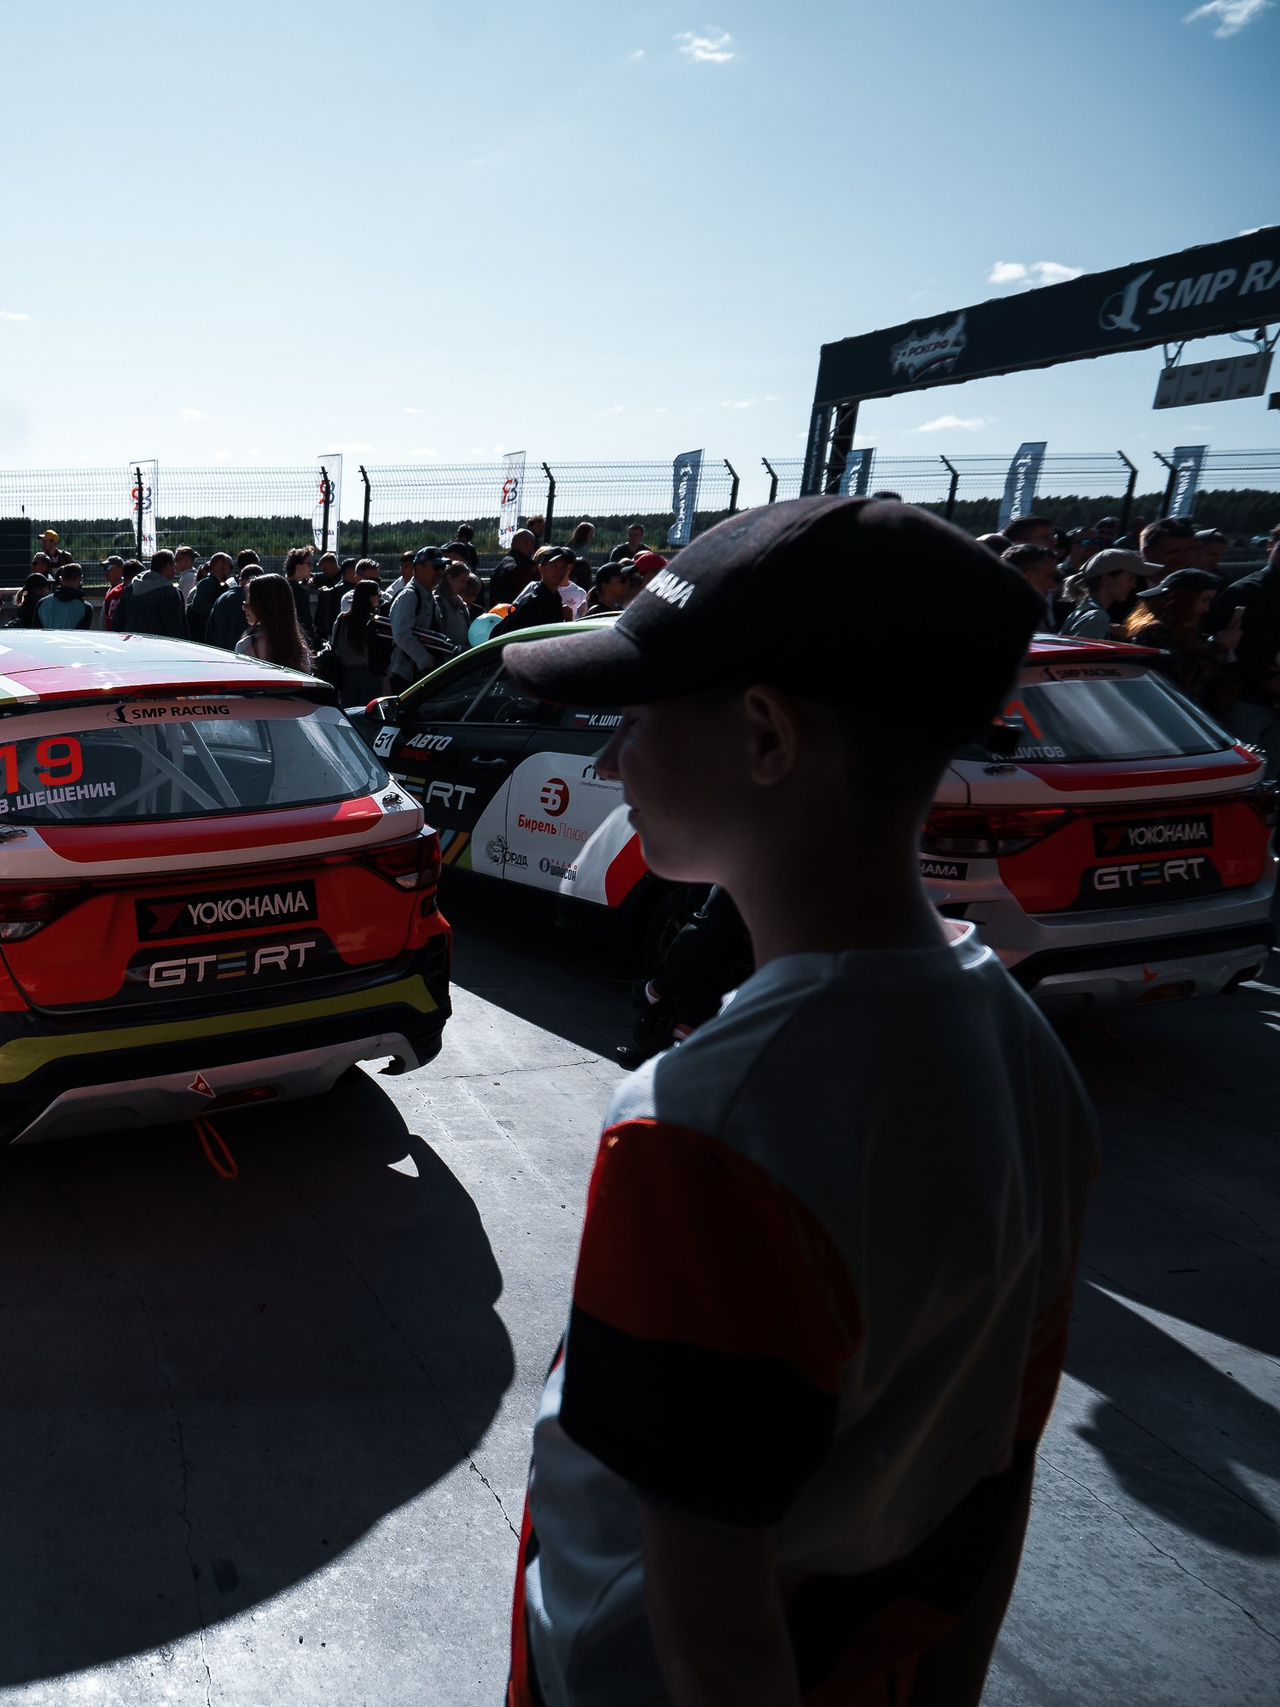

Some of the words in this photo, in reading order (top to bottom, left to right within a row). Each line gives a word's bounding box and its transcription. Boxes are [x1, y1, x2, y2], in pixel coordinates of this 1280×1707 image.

[1146, 268, 1238, 315] SMP
[131, 706, 170, 720] SMP
[172, 705, 230, 718] RACING
[588, 714, 624, 727] К.ШИТ
[375, 733, 394, 749] 51
[405, 733, 453, 752] АВТО
[518, 814, 557, 836] Бирель
[1128, 822, 1208, 846] YOKOHAMA
[187, 890, 309, 925] YOKOHAMA
